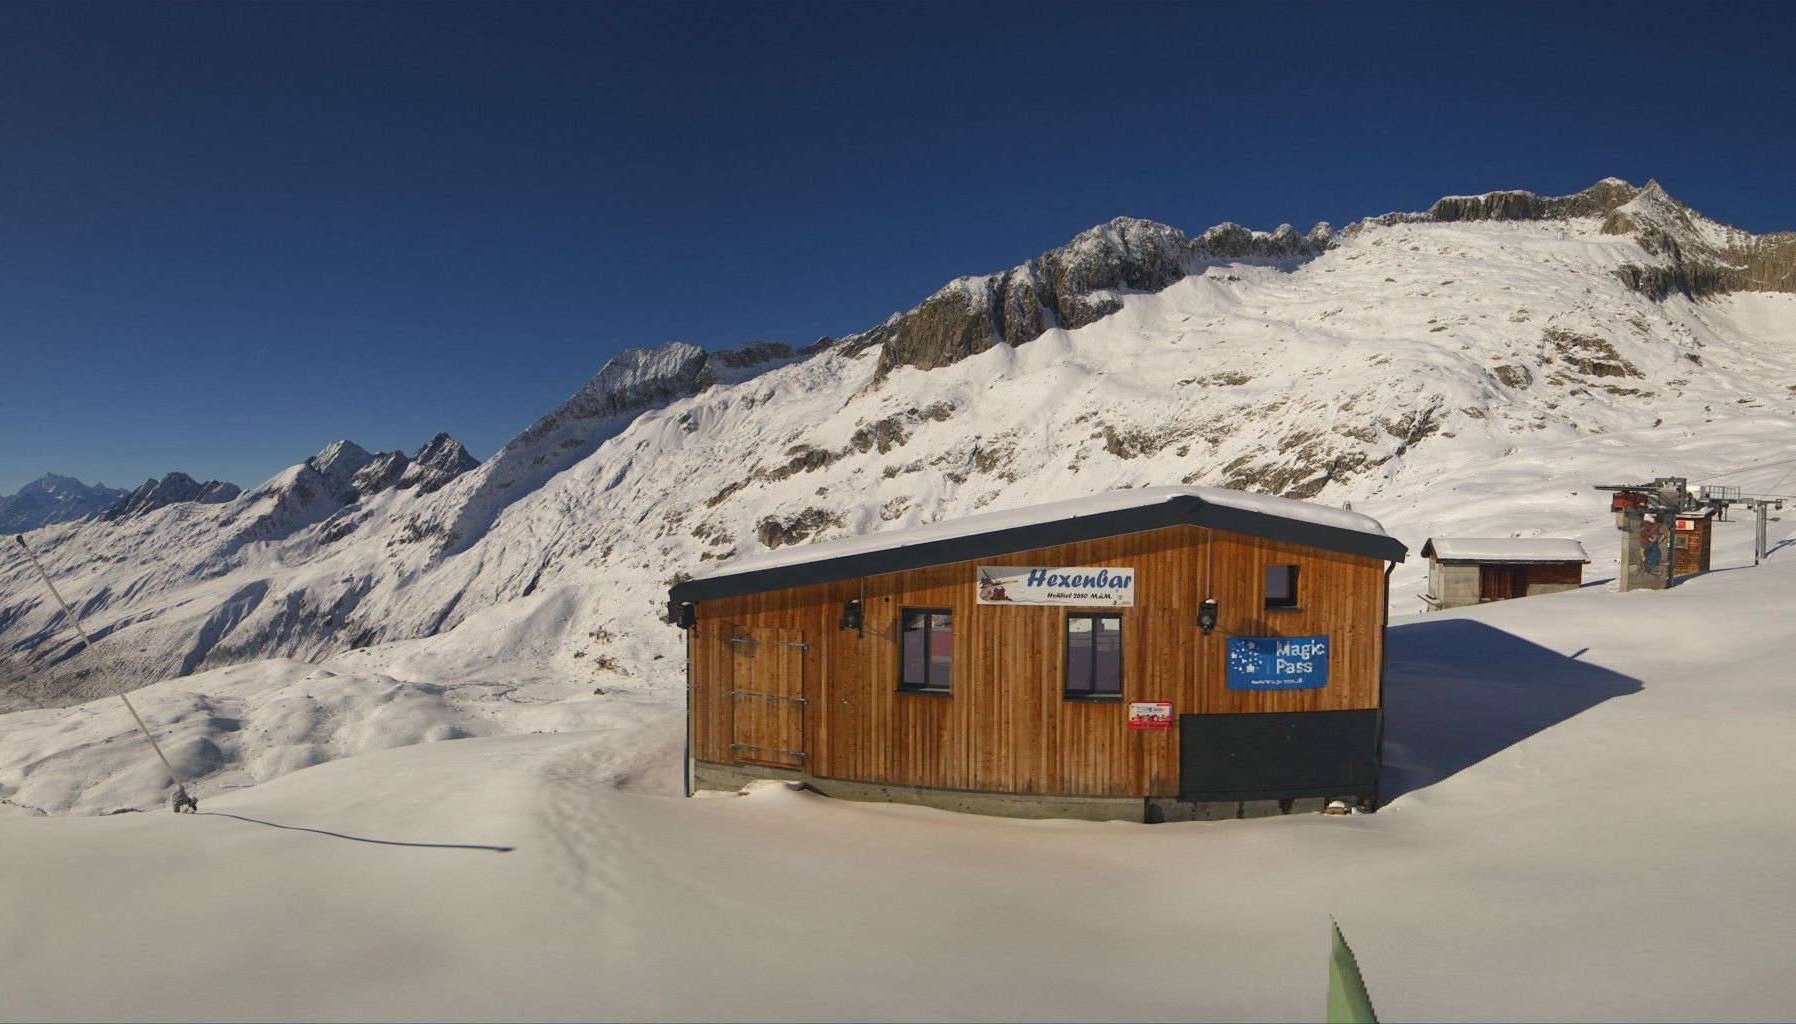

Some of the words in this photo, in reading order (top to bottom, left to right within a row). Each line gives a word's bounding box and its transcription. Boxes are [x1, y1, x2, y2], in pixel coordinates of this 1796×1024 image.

[1027, 569, 1132, 588] Hexenbar
[1276, 639, 1325, 660] Magic
[1276, 658, 1313, 674] Pass
